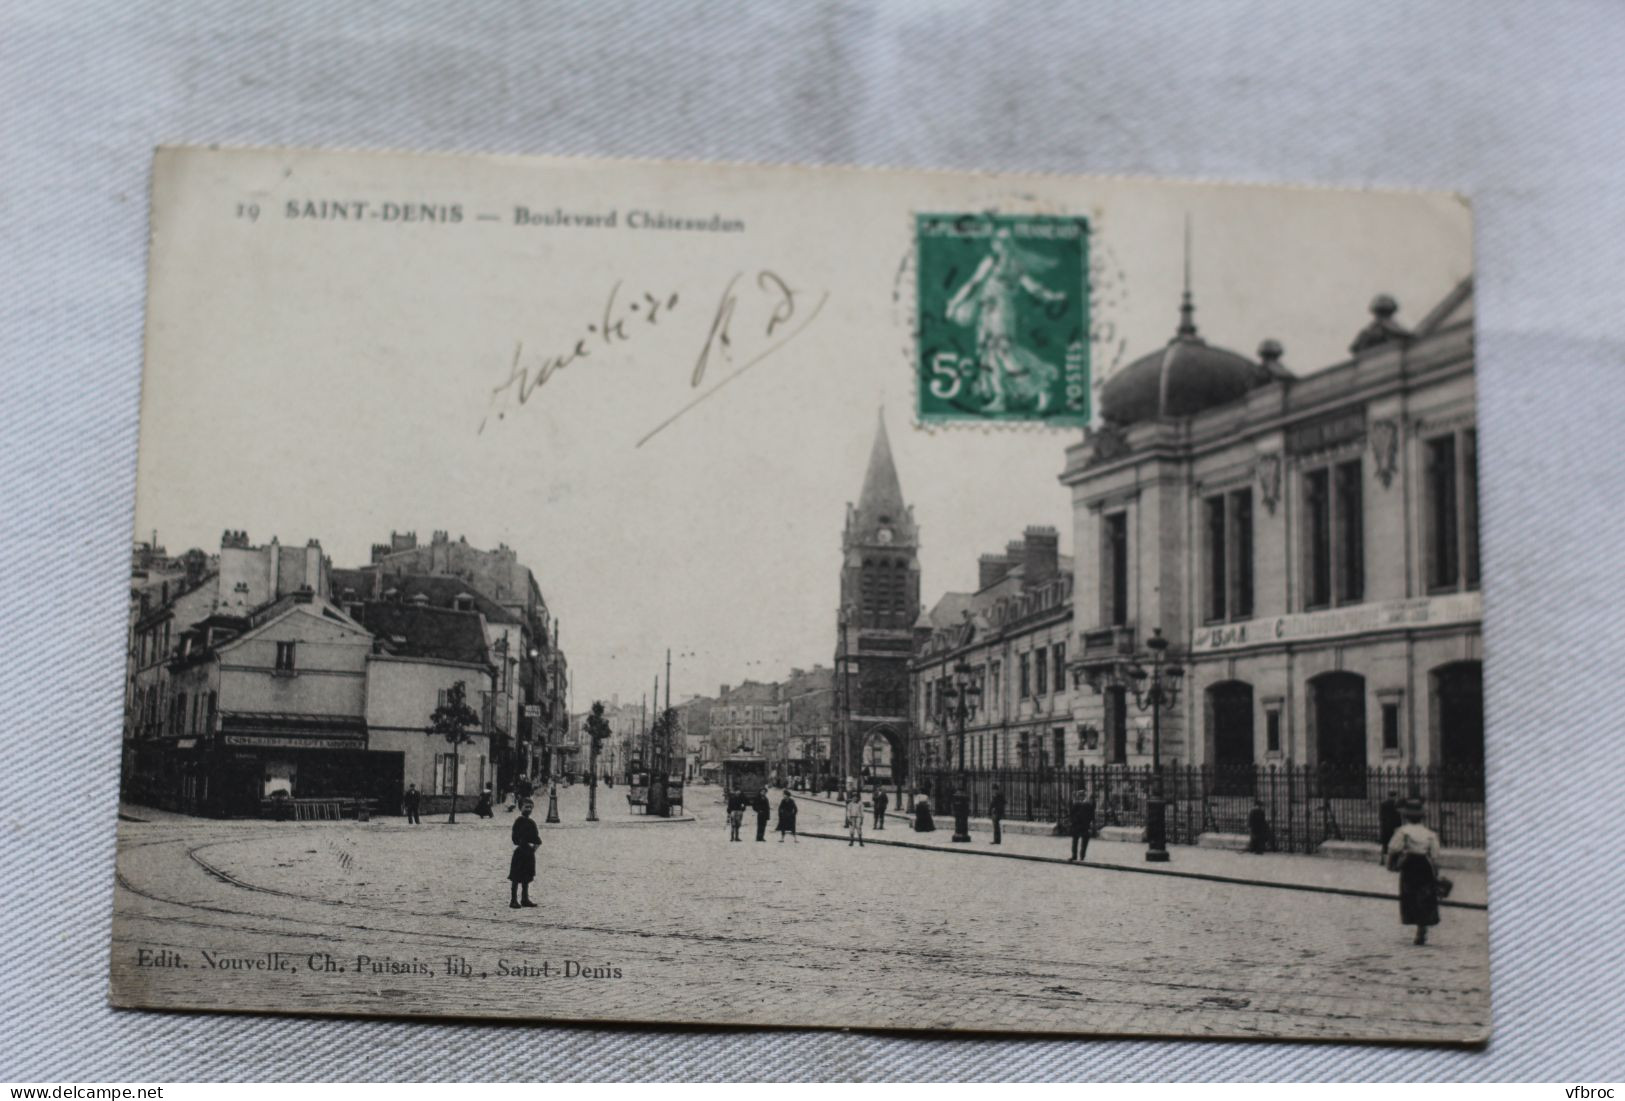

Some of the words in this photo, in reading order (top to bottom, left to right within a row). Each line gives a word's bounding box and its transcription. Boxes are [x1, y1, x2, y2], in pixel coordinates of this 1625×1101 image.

[236, 201, 261, 223] 19
[285, 200, 464, 223] SAINT-DENIS
[513, 205, 618, 229] Boulevard
[626, 209, 746, 233] Châteaudun
[136, 948, 189, 969] Edit.
[200, 950, 298, 974] Nouvelle,
[307, 952, 345, 974] Ch.
[354, 954, 435, 978] Puisais,
